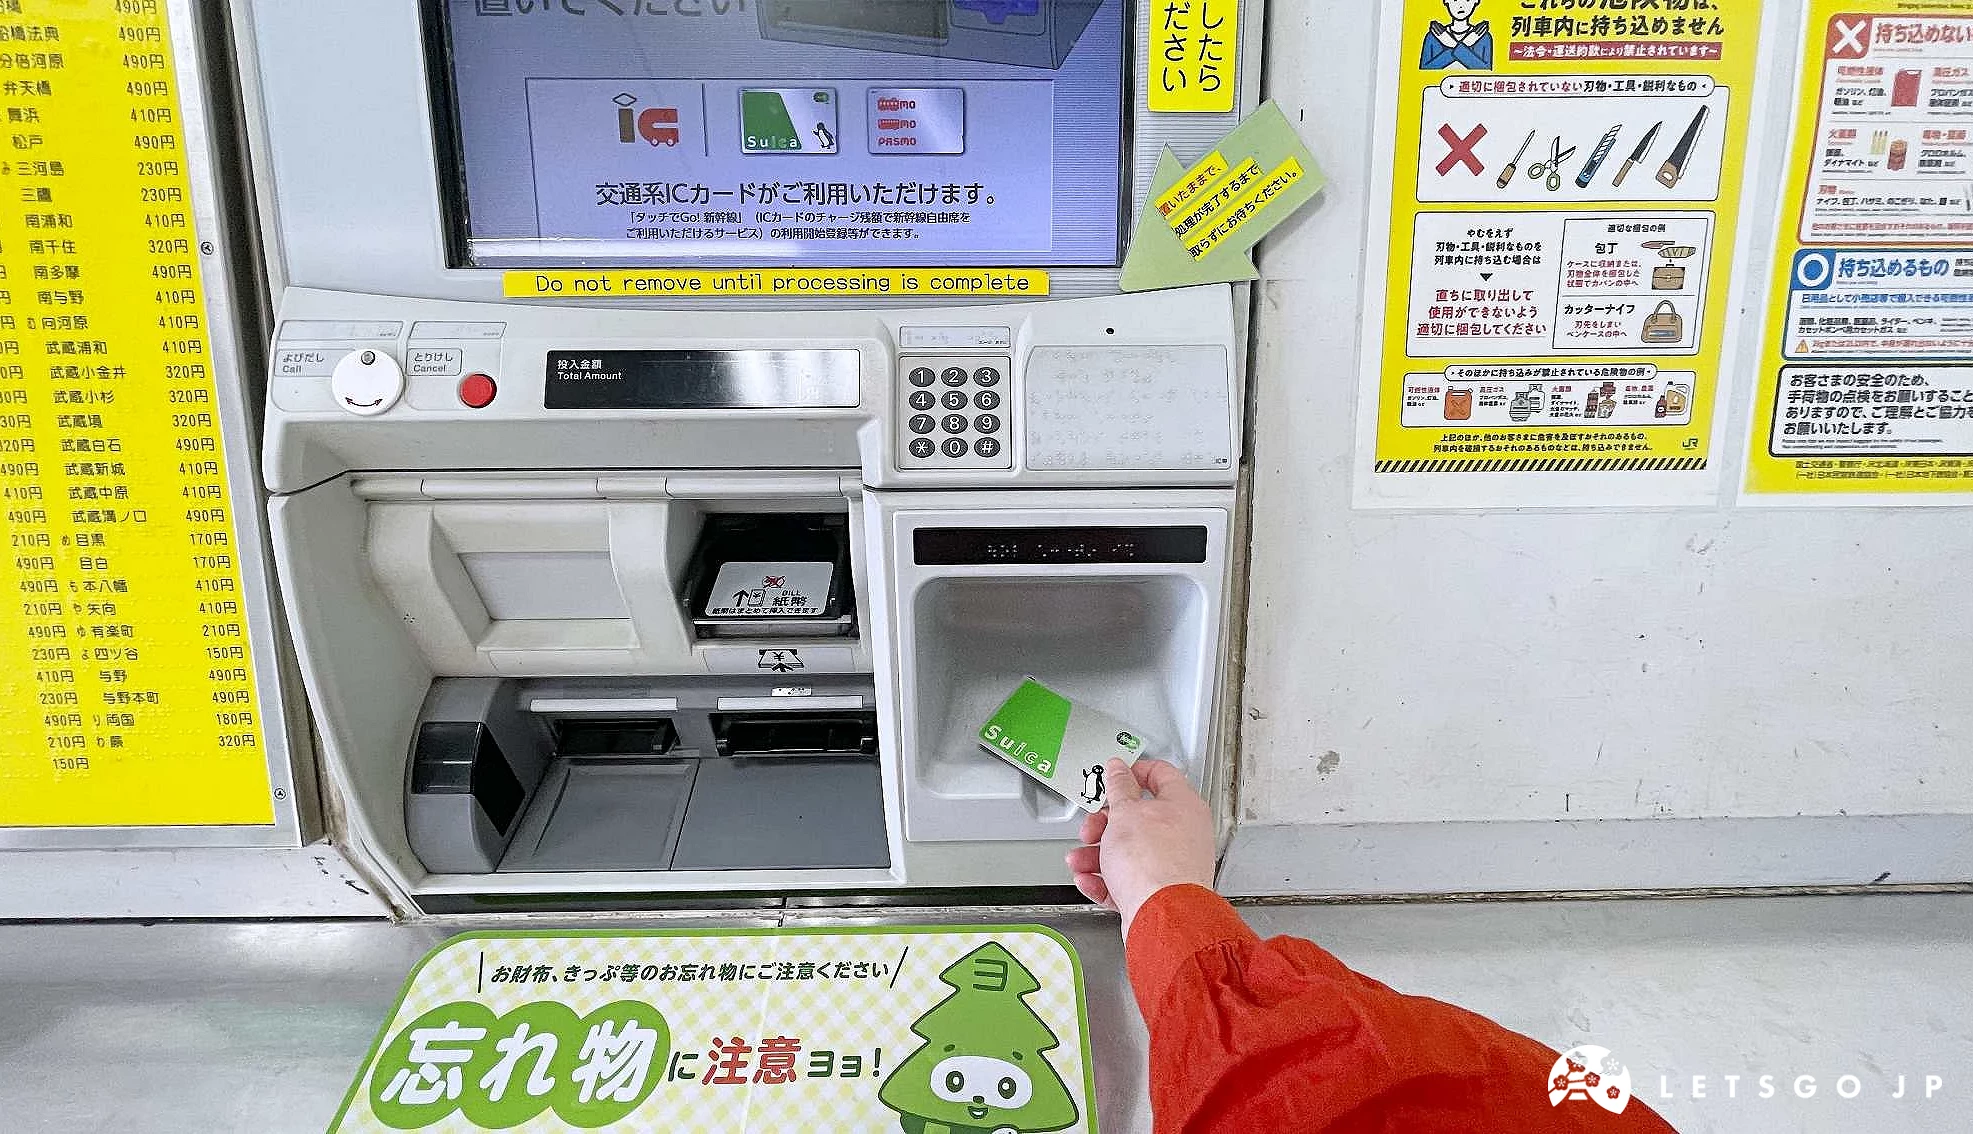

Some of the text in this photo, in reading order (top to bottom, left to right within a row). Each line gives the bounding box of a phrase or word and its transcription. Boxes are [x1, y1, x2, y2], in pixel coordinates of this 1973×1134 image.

[1511, 16, 1725, 37] 列車内に持ち込めません
[119, 27, 160, 42] 490円
[1162, 2, 1190, 92] ださい
[1198, 2, 1224, 92] したら
[123, 54, 164, 69] 490円
[127, 82, 168, 96] 490円
[131, 109, 171, 123] 410円
[134, 136, 175, 150] 490円
[138, 162, 179, 176] 230円
[141, 188, 182, 202] 230円
[595, 182, 995, 206] 交通系ICカードがご利用いただけます。
[1189, 170, 1297, 258] 取らずにお待ちください。
[145, 214, 185, 228] 410円
[29, 240, 188, 255] 南千住 320円
[1594, 242, 1619, 255] 包丁
[152, 266, 192, 280] 490円
[1838, 257, 1950, 278] 持ち込めるもの
[537, 273, 1029, 292] Do not remove until processing is complete
[155, 291, 195, 304] 410円
[1435, 288, 1535, 302] 直ちに取り出して
[1428, 305, 1539, 319] 使用ができないよう
[1564, 304, 1636, 315] カッターナイフ
[159, 316, 198, 329] 410円
[1416, 323, 1547, 336] 適切に梱包してください
[162, 341, 202, 354] 410円
[414, 352, 454, 363] とりけし
[282, 364, 302, 374] Call
[413, 364, 447, 374] Cancel
[557, 359, 602, 370] 投入金額
[166, 365, 205, 379] 320円
[558, 371, 622, 381] Total Amount
[918, 369, 993, 384] 1 2 3
[1789, 373, 1930, 387] お客さまの安全のため、
[169, 390, 208, 403] 320円
[915, 392, 993, 407] 4 5 6
[172, 414, 212, 427] 320円
[916, 416, 993, 431] 7 8 9
[1783, 421, 1892, 435] お願いいたします。
[176, 438, 215, 451] 490円
[949, 440, 994, 454] 0 #
[1682, 438, 1699, 447] JR
[1, 463, 39, 476] 490円
[179, 462, 218, 475] 410円
[4, 487, 43, 499] 410円
[182, 486, 221, 499] 410円
[8, 510, 46, 523] 490円
[185, 510, 224, 522] 490円
[12, 534, 50, 546] 210円
[76, 533, 228, 546] 目黒 170円
[16, 557, 54, 570] 490円
[193, 556, 231, 568] 170円
[20, 580, 58, 592] 490円
[195, 579, 234, 592] 410円
[24, 603, 62, 615] 210円
[199, 602, 237, 614] 410円
[28, 625, 66, 638] 490円
[91, 624, 240, 638] 有楽町 210円
[32, 648, 70, 660] 230円
[94, 646, 244, 660] 四ツ谷 150円
[36, 670, 74, 682] 410円
[99, 669, 247, 682] 与野 490円
[40, 692, 78, 704] 230円
[103, 691, 249, 704] 与野本町 490円
[44, 714, 81, 726] 490円
[106, 713, 252, 727] 両国 180円
[47, 736, 85, 748] 210円
[219, 735, 255, 747] 320円
[984, 725, 1053, 774] Suica
[53, 757, 89, 769] 150円
[491, 961, 889, 983] お財布、きっぷ等のお忘れ物にご注意ください
